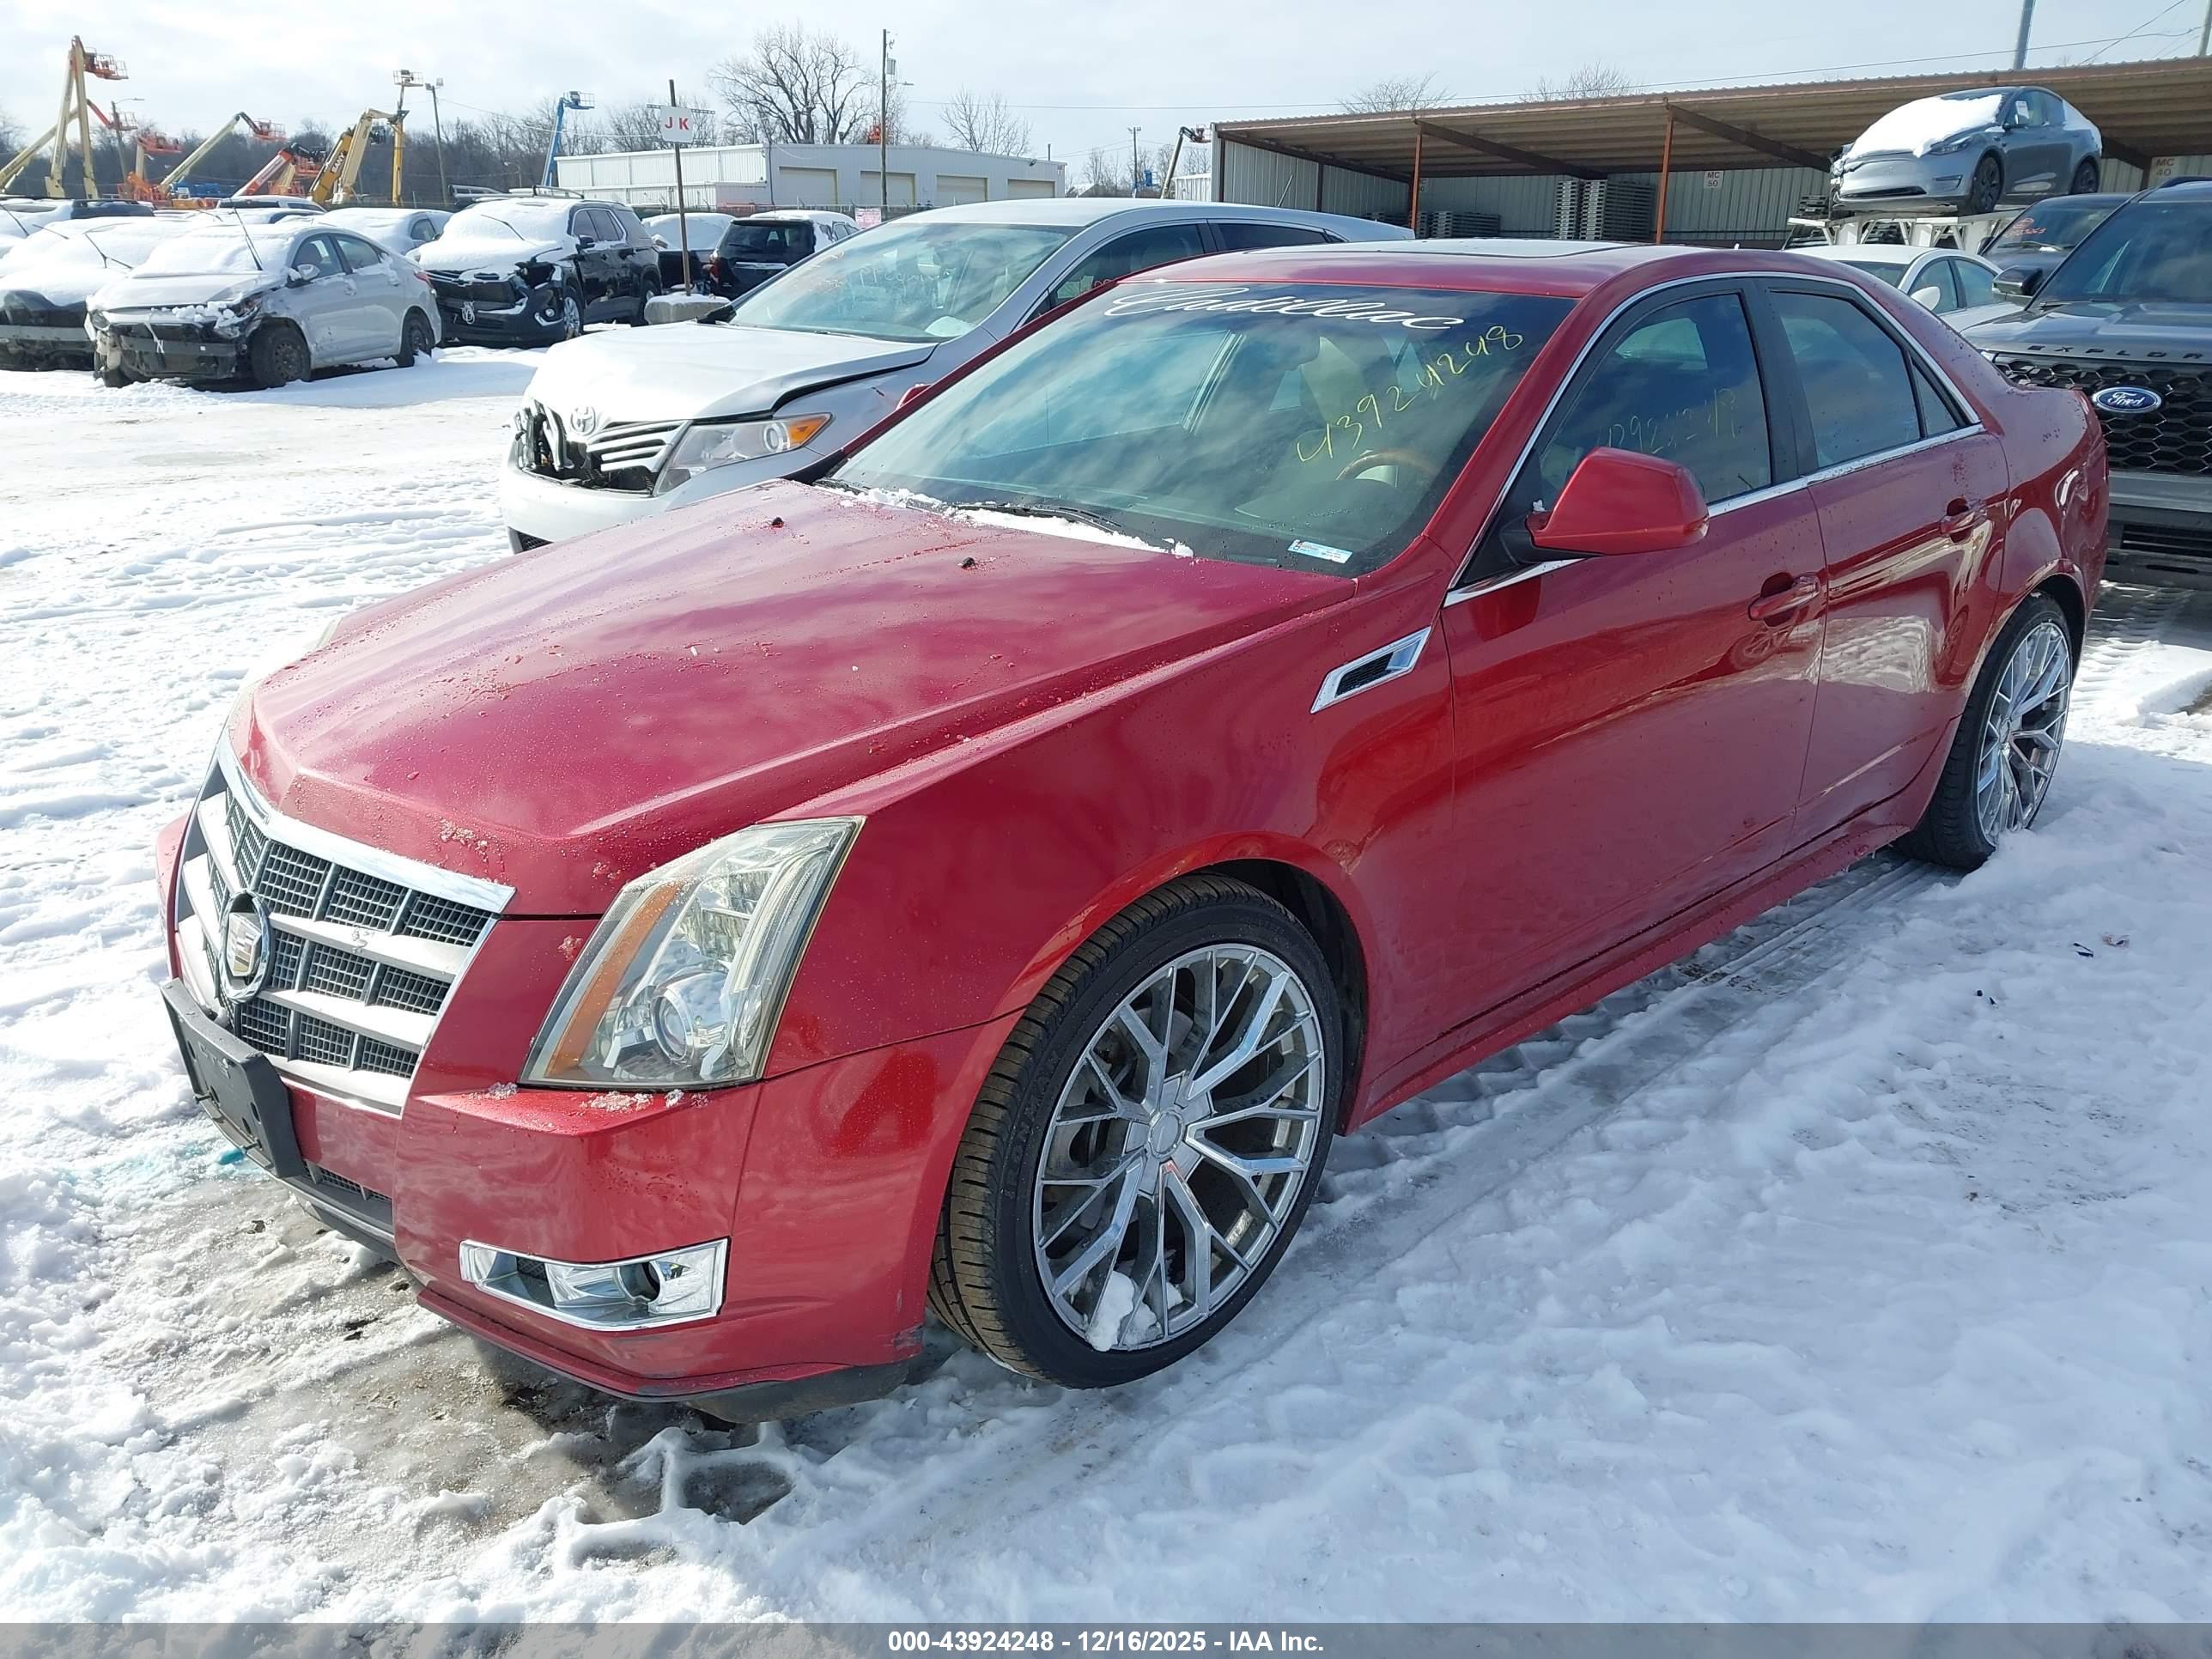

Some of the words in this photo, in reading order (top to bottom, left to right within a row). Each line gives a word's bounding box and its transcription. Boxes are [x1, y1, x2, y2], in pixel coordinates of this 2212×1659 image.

[1103, 286, 1465, 330] Cadillac
[1295, 325, 1523, 463] 43924248
[2107, 392, 2146, 407] Ford
